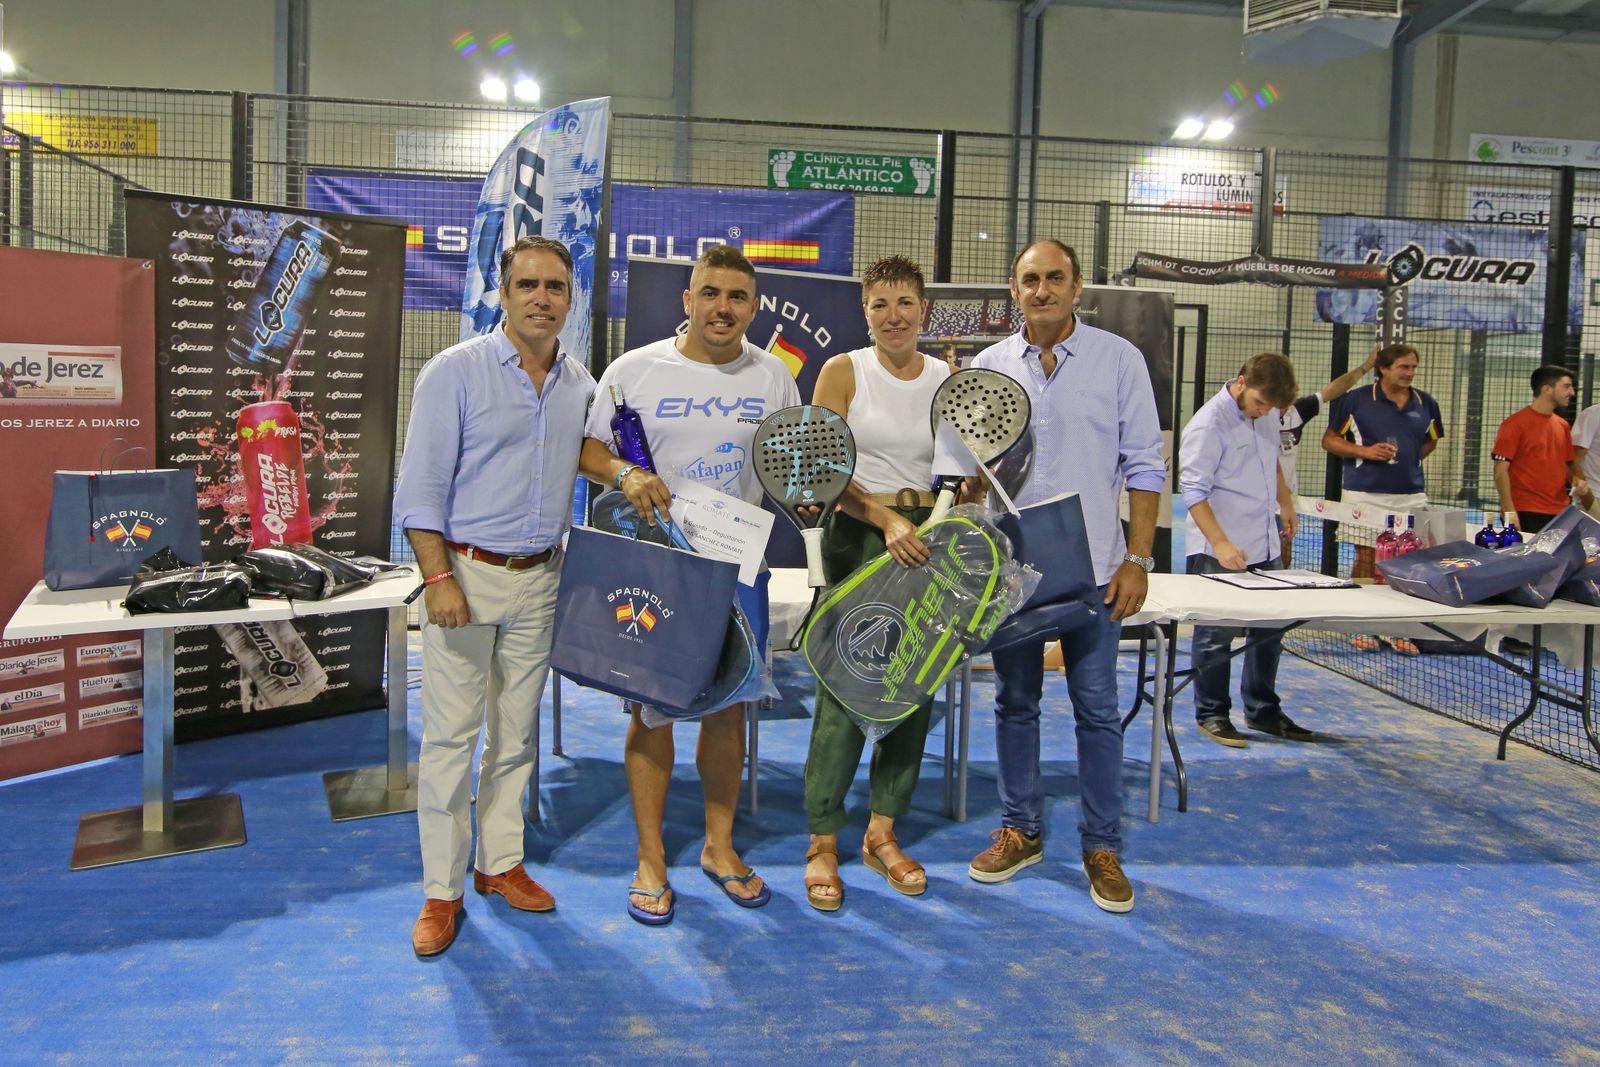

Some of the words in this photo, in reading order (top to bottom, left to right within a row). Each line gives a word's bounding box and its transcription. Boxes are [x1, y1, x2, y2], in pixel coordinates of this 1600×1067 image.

[84, 140, 100, 150] 956
[801, 165, 904, 184] ATLÁNTICO
[1181, 172, 1233, 188] ROTULOS
[1239, 174, 1247, 188] Y
[172, 230, 214, 240] LOCURA
[172, 252, 214, 263] LOCURA
[334, 266, 368, 276] OCURA
[1236, 262, 1280, 272] MUEBLES
[1281, 264, 1295, 274] DE
[1296, 266, 1336, 278] HOGAR
[172, 275, 214, 286] LOCURA
[253, 240, 314, 346] LOCURA
[172, 298, 214, 308] LOCURA
[172, 320, 214, 330] LOCURA
[172, 342, 214, 352] LOCURA
[11, 356, 42, 377] de
[46, 357, 104, 382] Jerez
[171, 364, 213, 375] LOCURA
[171, 387, 213, 397] LOCURA
[656, 396, 766, 418] EKYS
[170, 409, 212, 419] LOCURA
[26, 418, 74, 428] JEREZ
[78, 418, 88, 428] A
[92, 418, 140, 428] DIARIO
[170, 453, 212, 463] LOCURA
[274, 462, 297, 520] REBELDE
[258, 453, 288, 546] LOCURA
[92, 510, 165, 530] SPAGNOLO
[607, 588, 670, 618] SPAGNOLO
[175, 644, 208, 655] OCURA
[175, 665, 208, 676] OCURA
[82, 676, 114, 688] Huelva
[175, 685, 208, 696] OCURA
[175, 706, 208, 717] OCURA
[0, 724, 36, 736] Málaga
